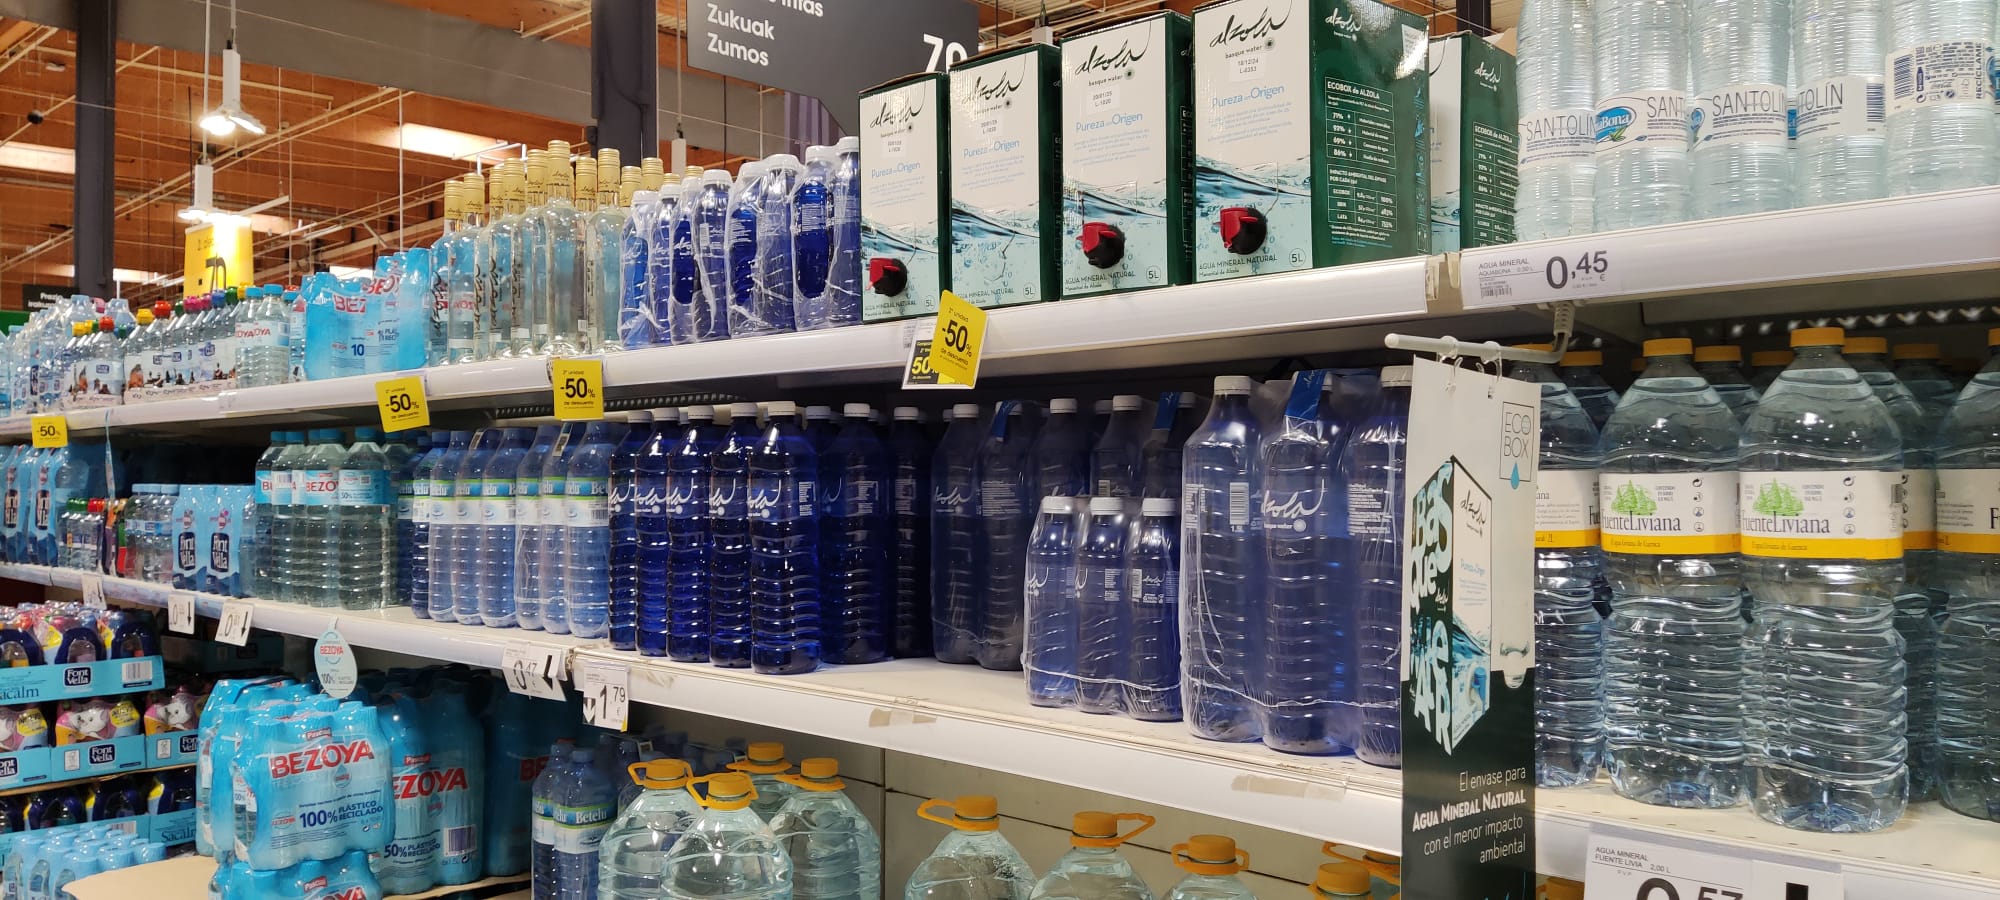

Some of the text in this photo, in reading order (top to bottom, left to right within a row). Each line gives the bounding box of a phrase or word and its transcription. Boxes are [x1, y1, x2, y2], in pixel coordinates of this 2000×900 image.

[707, 3, 775, 40] Zukuak
[707, 32, 769, 66] Zumos
[1212, 85, 1285, 108] Pureza Origen
[1328, 81, 1352, 92] ECOBOX
[1076, 113, 1143, 133] Pureza Origen
[963, 139, 1020, 159] Pureza Origen
[1217, 259, 1246, 269] MINERAL
[1246, 255, 1278, 266] NATURAL
[1479, 258, 1529, 270] AGUA MINERAL
[1546, 250, 1609, 290] 0,45
[1081, 274, 1107, 283] MINERAL
[1108, 270, 1136, 279] NATURAL
[942, 319, 972, 358] -50%
[560, 378, 596, 398] -50%
[385, 393, 420, 413] -50%
[1504, 412, 1532, 435] ECO
[1504, 436, 1529, 459] BOX
[67, 668, 89, 678] Font
[67, 676, 89, 685] Vella
[91, 746, 113, 755] Font
[91, 753, 114, 762] Vella
[270, 740, 375, 779] BEZOYA
[1459, 766, 1526, 792] El envase para
[300, 809, 338, 828] 100%
[576, 808, 607, 824] Betelu
[1412, 789, 1526, 832] AGUA MINERAL NATURAL
[1424, 812, 1523, 856] con el menor impacto
[384, 844, 407, 859] 50%
[1480, 833, 1526, 863] ambiental
[1595, 846, 1649, 862] AGUA MINERAL
[1594, 853, 1624, 866] FUENTE
[1625, 858, 1643, 868] LIVIA
[1650, 863, 1665, 873] 2,00
